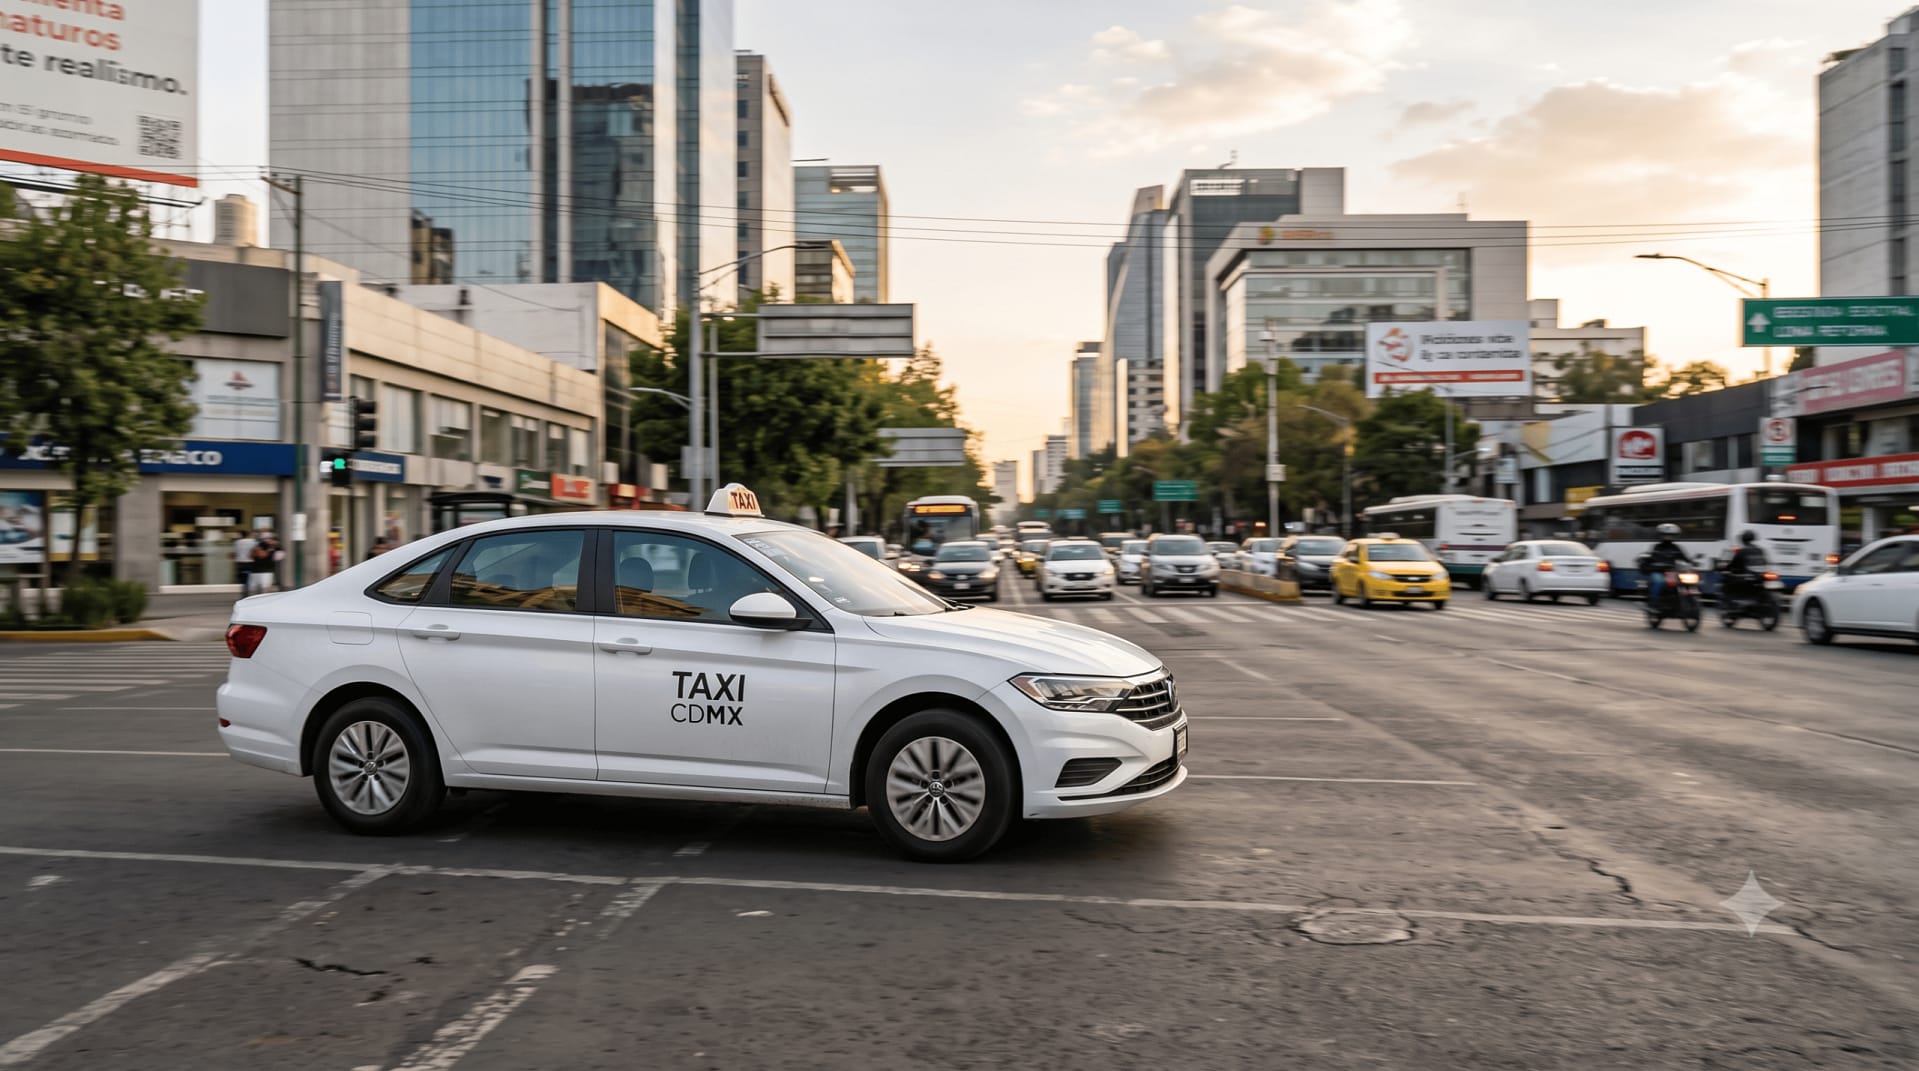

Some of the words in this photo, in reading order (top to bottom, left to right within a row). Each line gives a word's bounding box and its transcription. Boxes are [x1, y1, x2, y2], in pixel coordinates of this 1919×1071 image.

[44, 54, 188, 95] realismo.
[730, 491, 757, 510] TAXI
[672, 671, 746, 702] TAXI
[670, 703, 744, 726] CDMX
